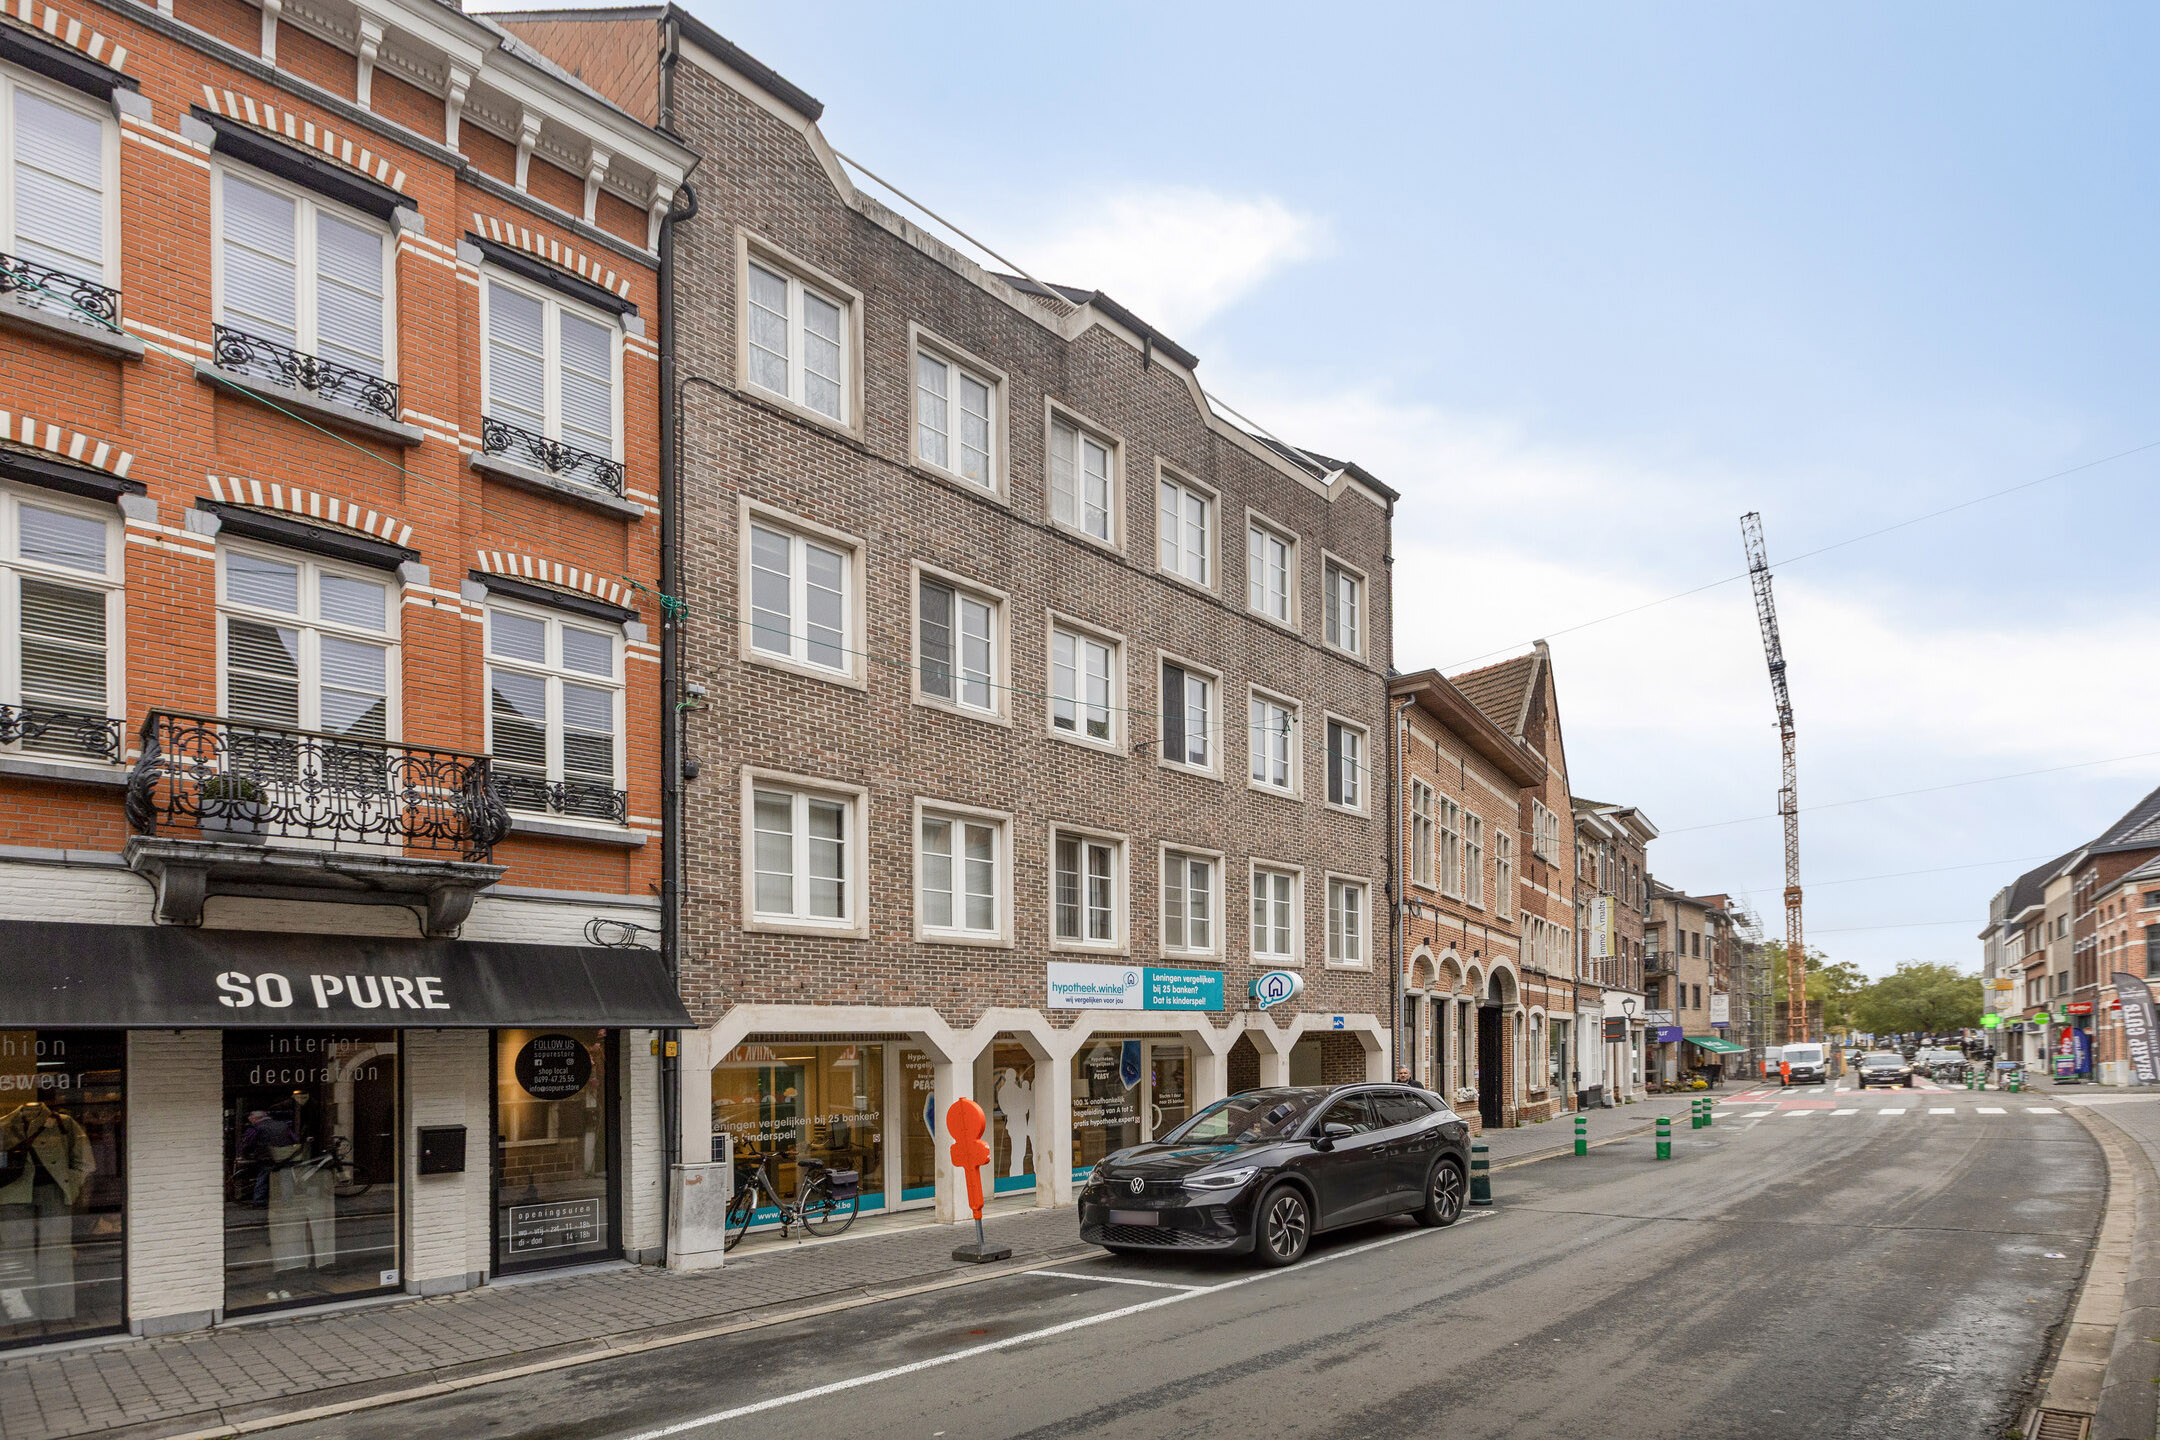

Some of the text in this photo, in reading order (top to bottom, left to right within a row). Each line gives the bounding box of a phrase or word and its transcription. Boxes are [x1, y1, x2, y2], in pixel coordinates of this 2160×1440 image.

[1152, 973, 1216, 985] Leningen vergelijken
[216, 971, 451, 1009] SO PURE
[1052, 981, 1124, 995] hypotheek.winkel
[1152, 984, 1199, 995] bij 25 banken?
[1065, 996, 1074, 1004] wij
[1075, 997, 1103, 1005] vergelijken
[1152, 996, 1207, 1007] Dat is kinderspel!
[2122, 1003, 2147, 1036] CUTS
[269, 1033, 362, 1054] interior
[533, 1039, 575, 1050] FOLLOW US
[533, 1050, 575, 1059] sopurestore
[2128, 1038, 2157, 1080] SHARP
[250, 1064, 379, 1085] decoration
[538, 1067, 569, 1076] shop local
[1093, 1072, 1110, 1080] PEASY
[1089, 1096, 1126, 1105] onafhankelijk
[1073, 1107, 1105, 1118] begeleiding
[758, 1116, 812, 1129] vergelijken
[814, 1114, 826, 1126] bij
[828, 1114, 840, 1123] 25
[842, 1111, 880, 1122] banken?
[1073, 1116, 1135, 1129] gratis hypotheek expert
[518, 1205, 591, 1220] openingsuren
[580, 1220, 591, 1230] 18h
[518, 1237, 525, 1247] di
[531, 1237, 543, 1245] don
[566, 1232, 574, 1241] 14
[580, 1230, 591, 1239] 18h
